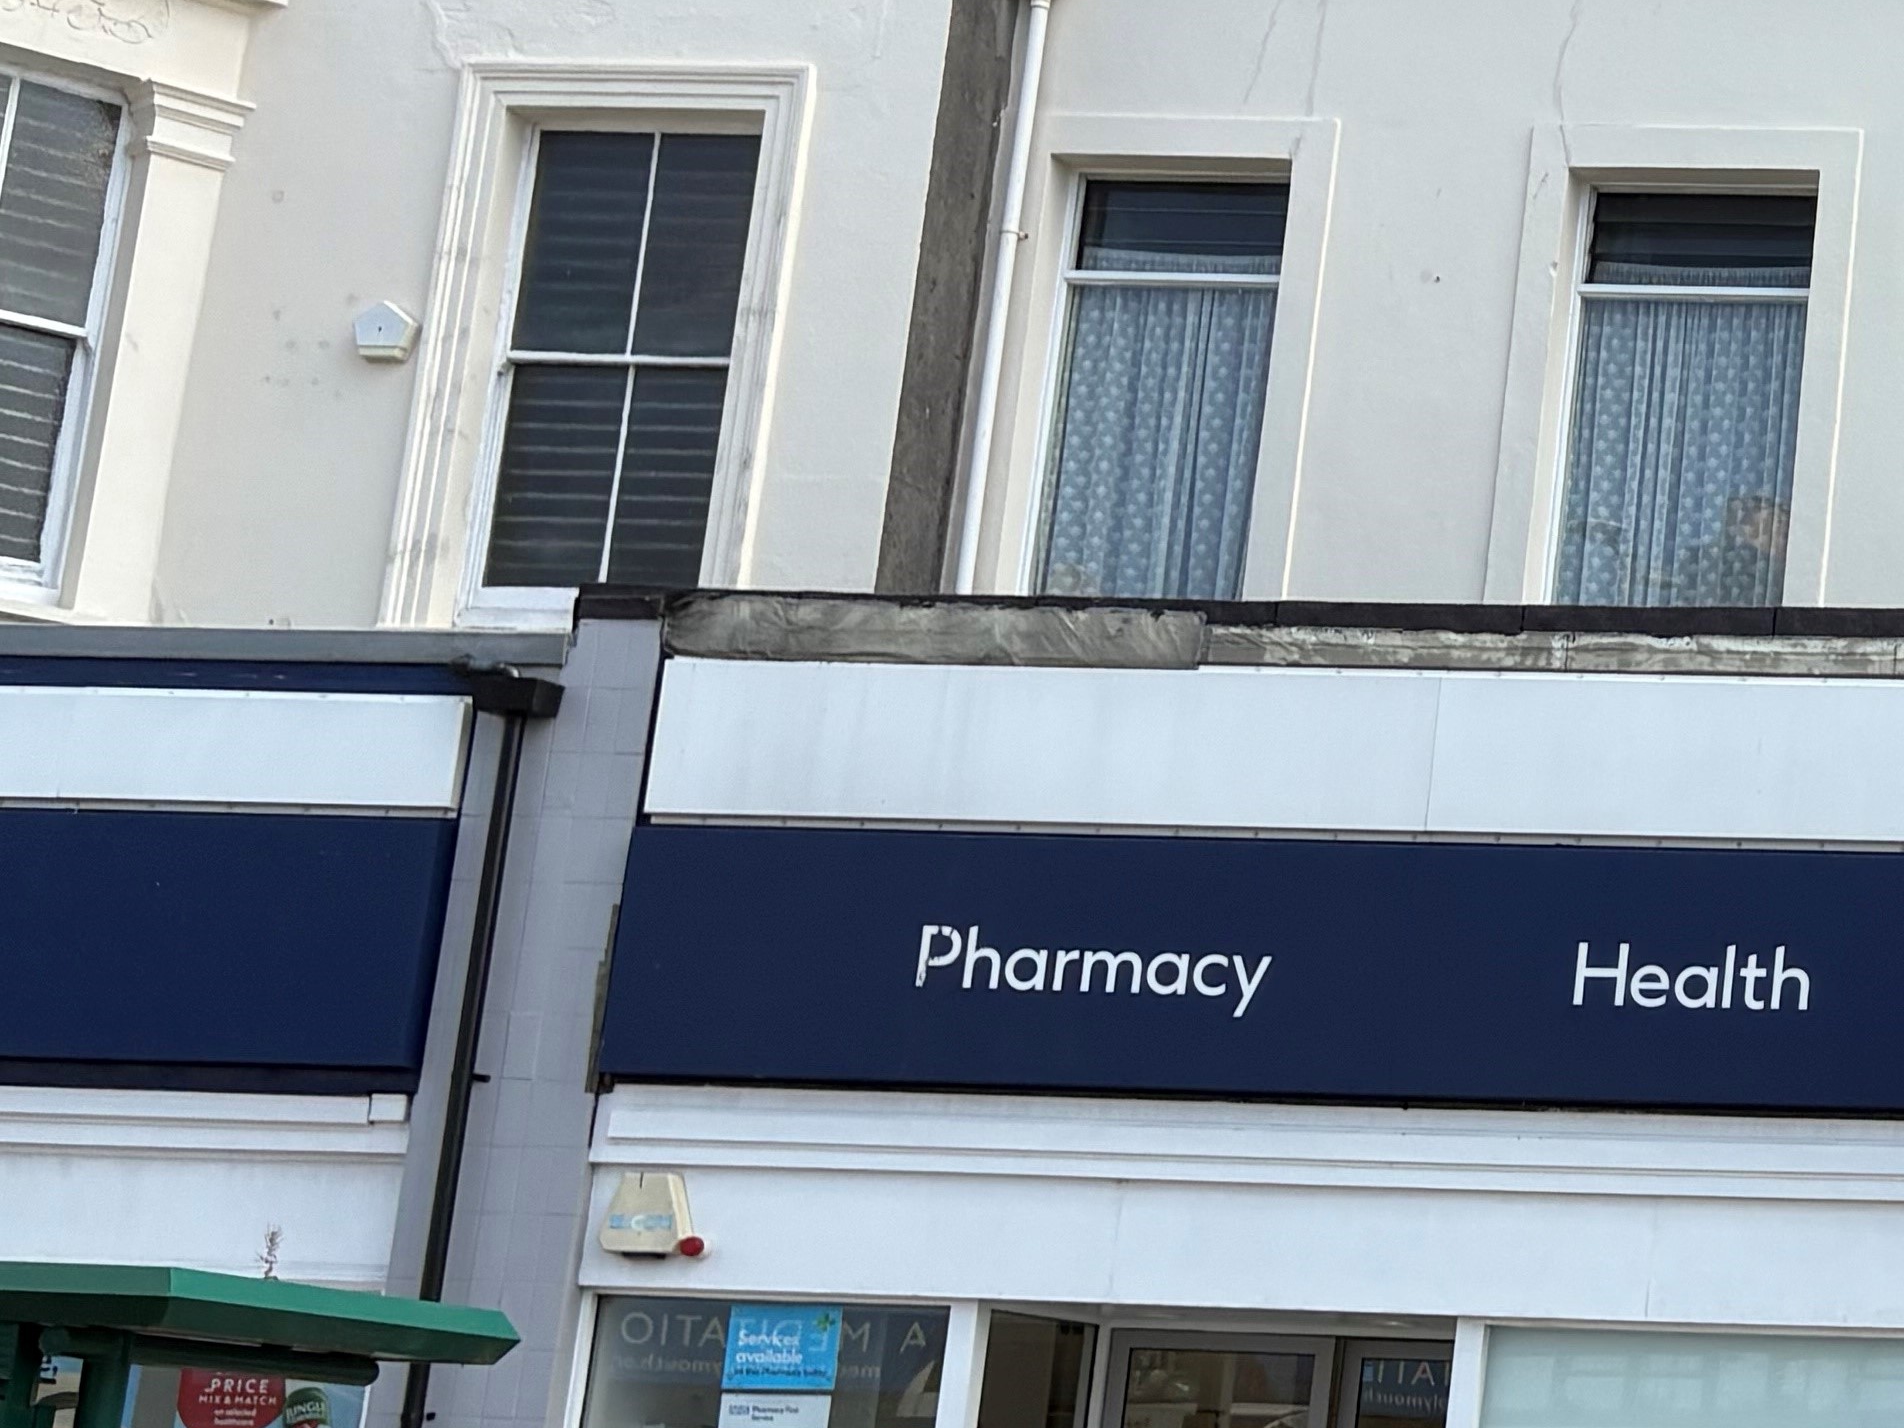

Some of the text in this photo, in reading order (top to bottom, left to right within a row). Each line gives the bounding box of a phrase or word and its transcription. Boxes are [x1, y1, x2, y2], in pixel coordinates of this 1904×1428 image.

[916, 924, 1811, 1018] Pharmacy Health
[210, 1378, 270, 1394] PRICE
